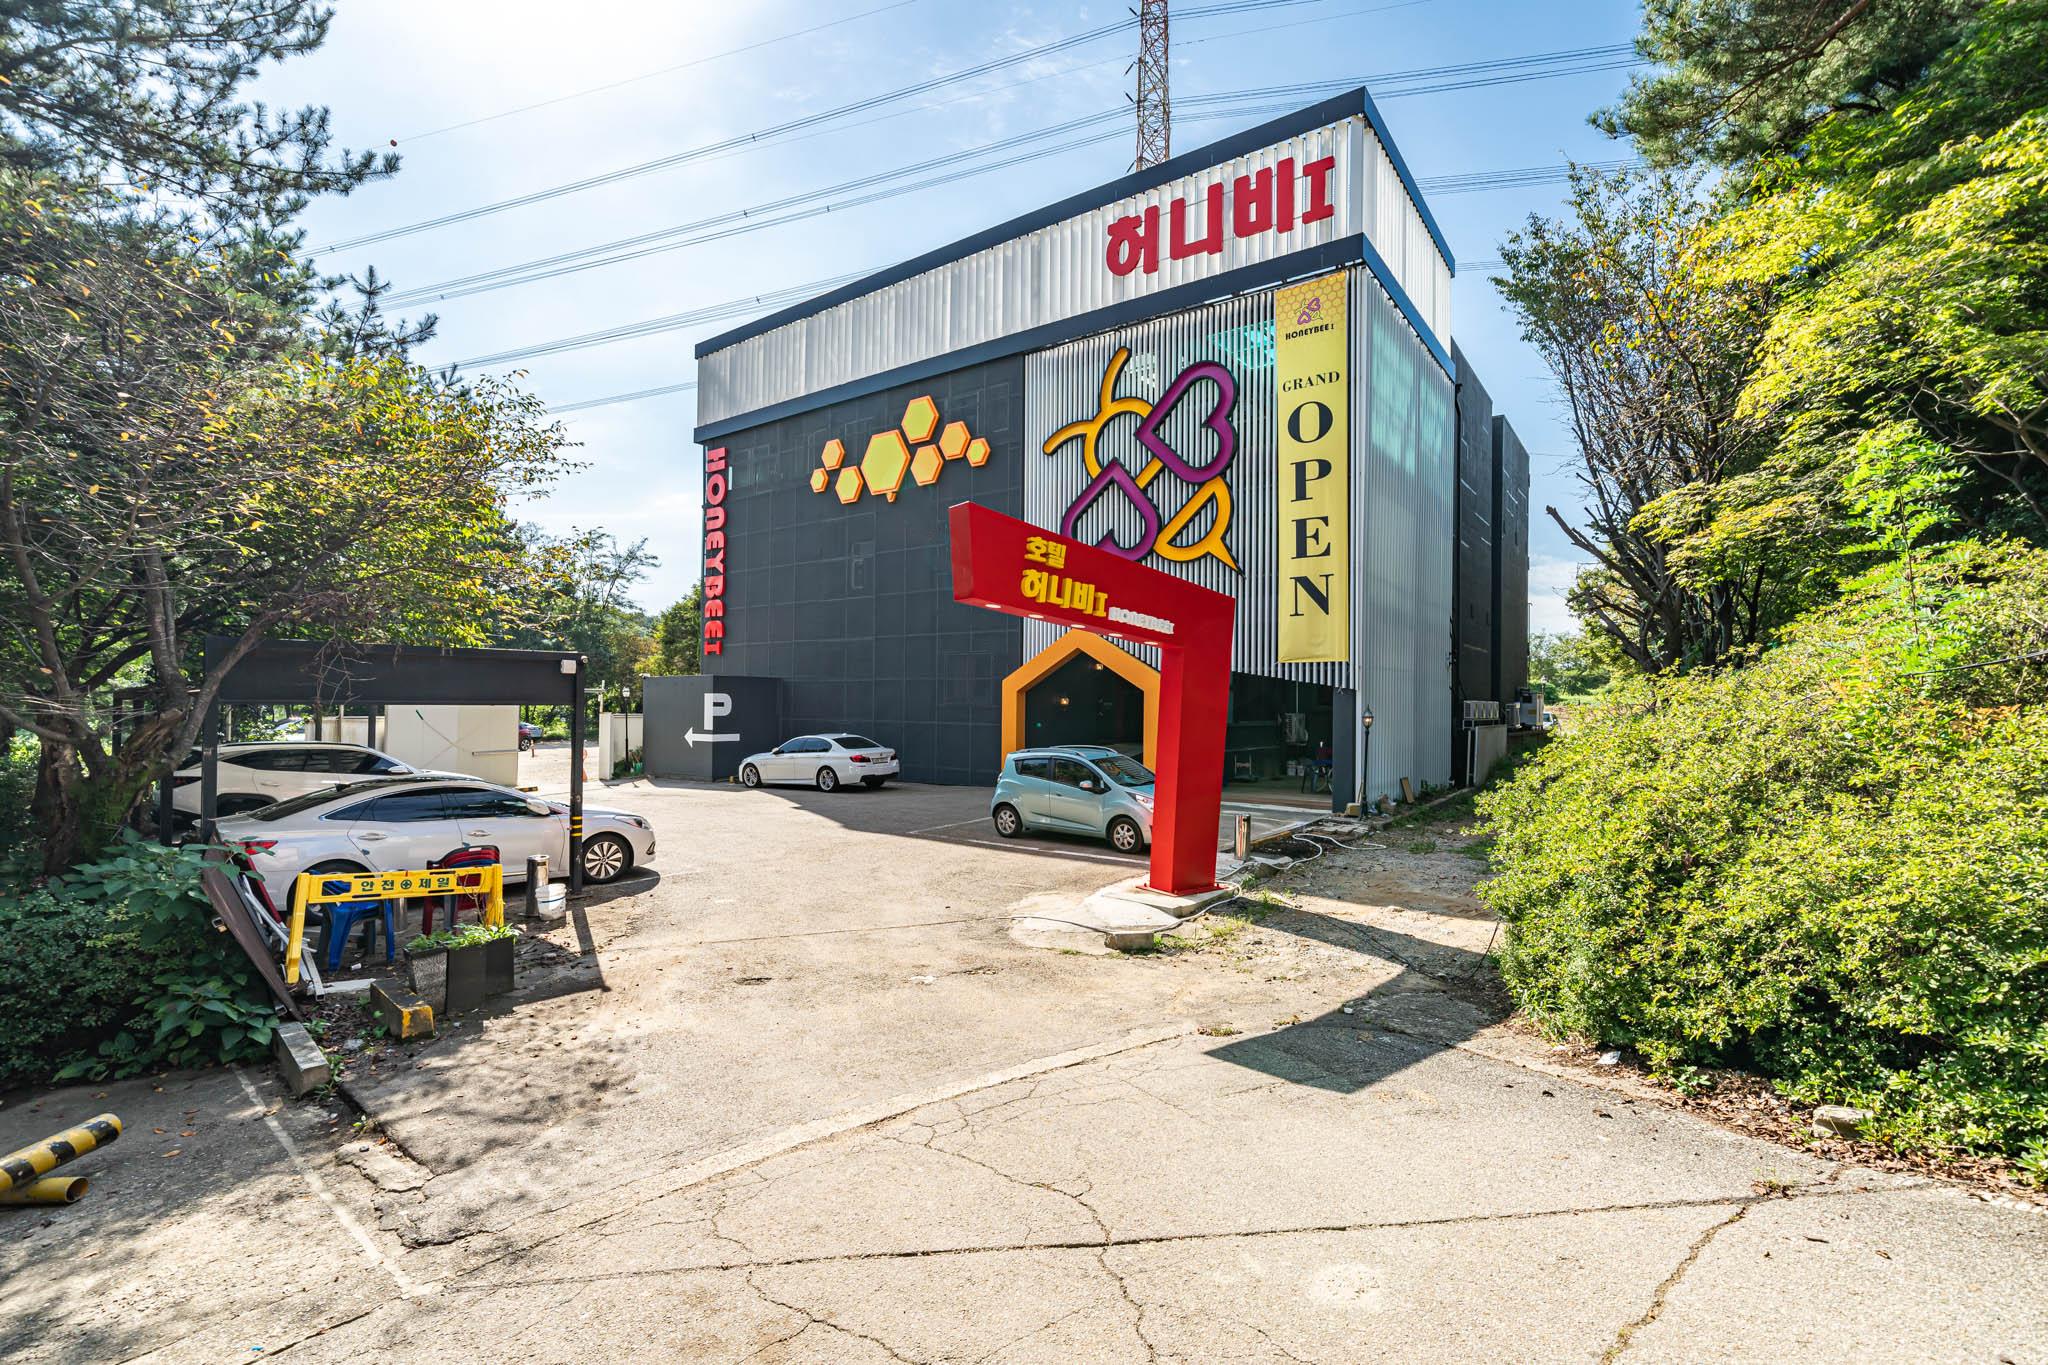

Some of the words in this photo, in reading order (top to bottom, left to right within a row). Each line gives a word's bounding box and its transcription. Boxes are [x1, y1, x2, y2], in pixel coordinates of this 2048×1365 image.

[1282, 370, 1341, 392] GRAND
[1287, 401, 1334, 617] OPEN
[1024, 536, 1067, 569] 호텔
[703, 692, 732, 730] P
